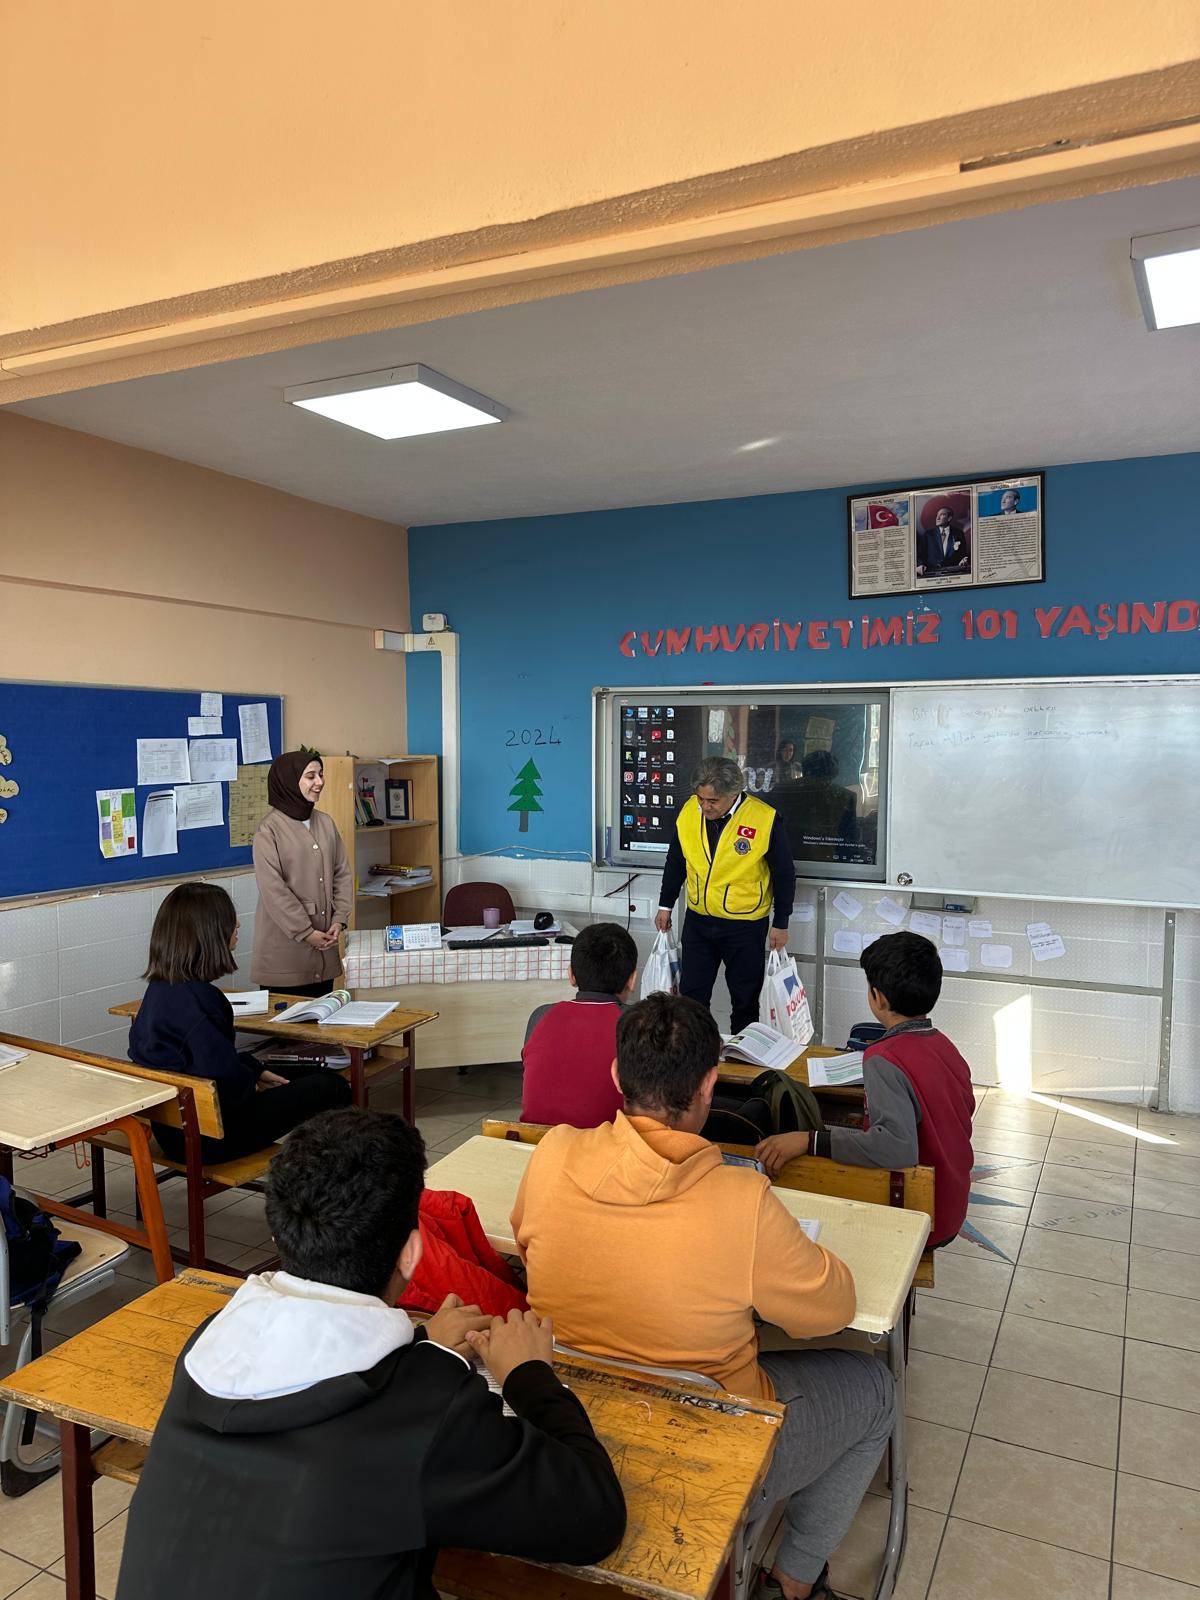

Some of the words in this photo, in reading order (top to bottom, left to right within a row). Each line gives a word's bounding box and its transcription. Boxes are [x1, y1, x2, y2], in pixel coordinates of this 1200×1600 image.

[618, 608, 941, 658] CUMHURİYETİMİZ
[961, 608, 1017, 640] 101
[1034, 600, 1200, 641] YAŞIND
[505, 725, 561, 747] 2024
